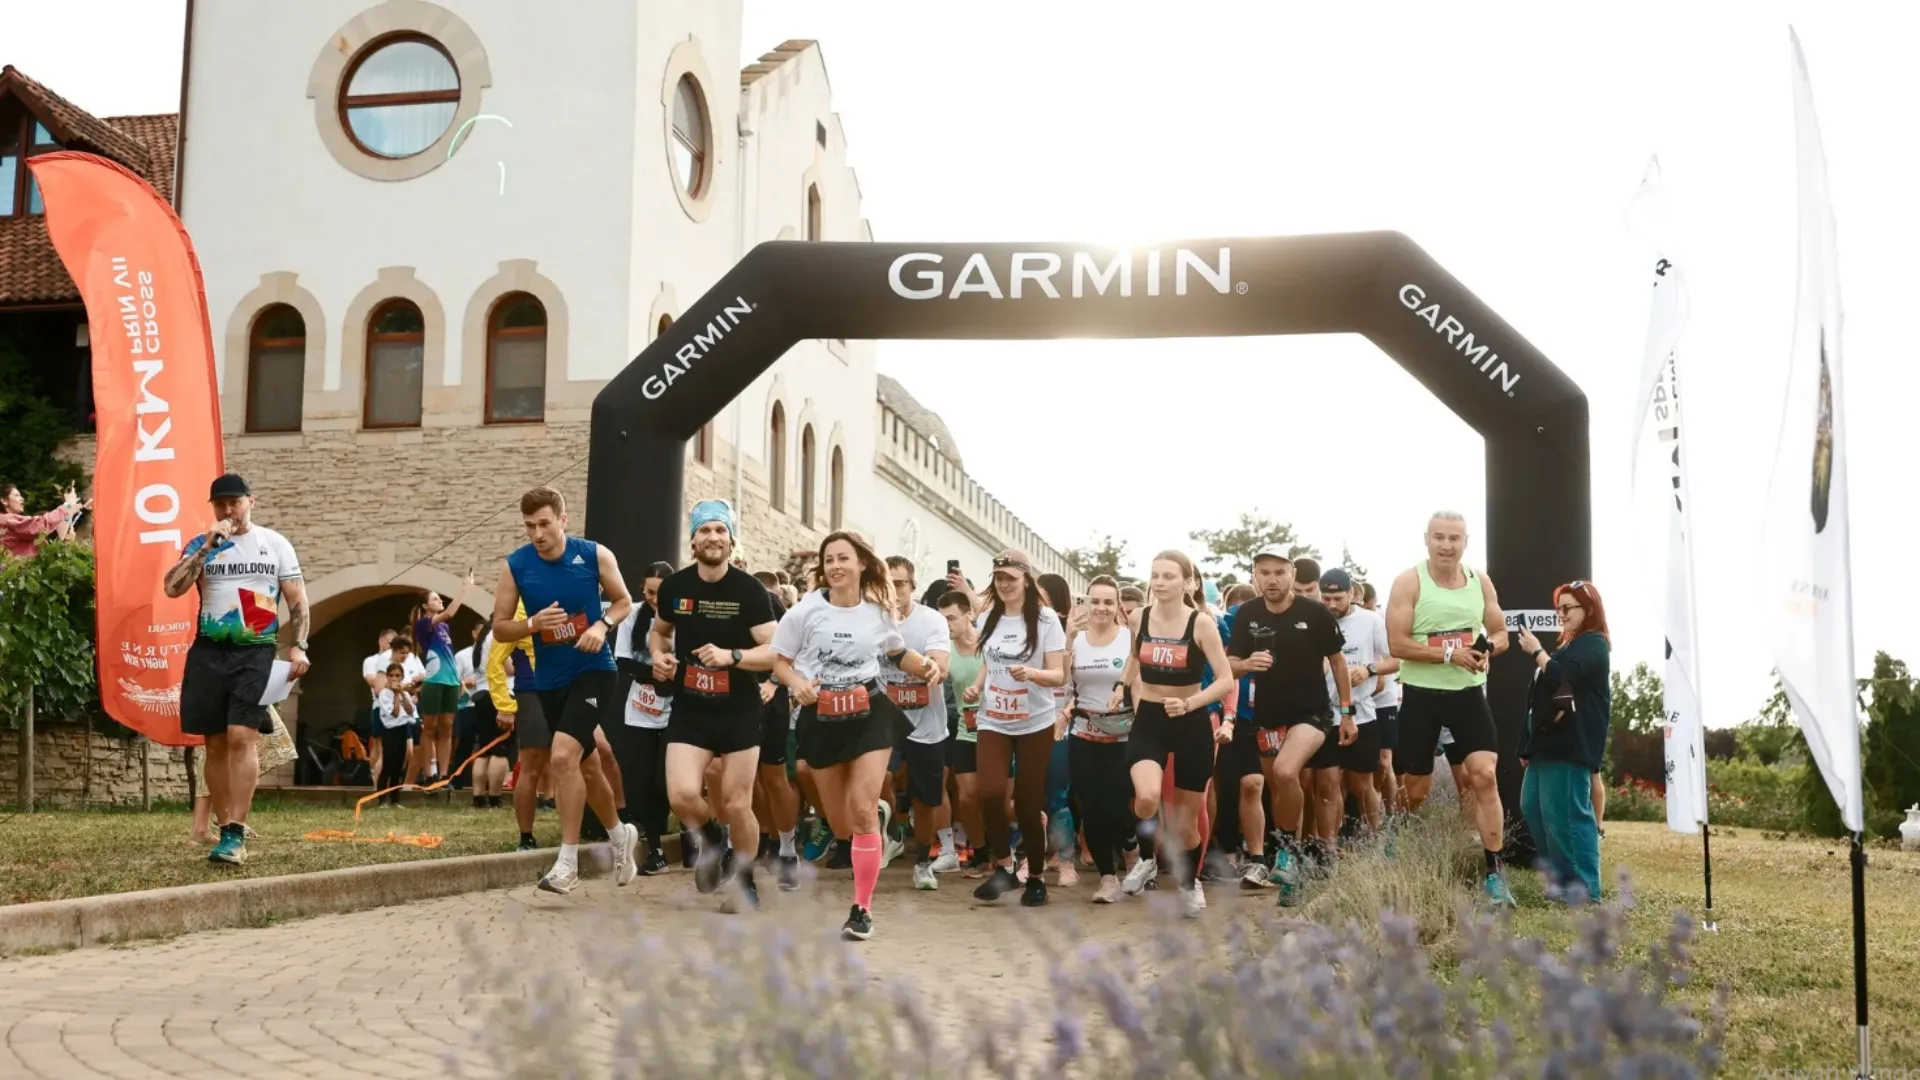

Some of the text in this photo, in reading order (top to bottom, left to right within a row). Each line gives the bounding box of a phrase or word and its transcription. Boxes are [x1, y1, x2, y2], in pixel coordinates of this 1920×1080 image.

[888, 248, 1231, 299] GARMIN
[1399, 284, 1521, 392] GARMIN
[641, 296, 753, 400] GARMIN
[205, 562, 275, 576] RUN MOLDOVA
[1505, 614, 1558, 629] ea yest
[1152, 646, 1174, 664] 075
[696, 672, 714, 690] 231
[832, 694, 855, 713] 111
[995, 695, 1018, 711] 514
